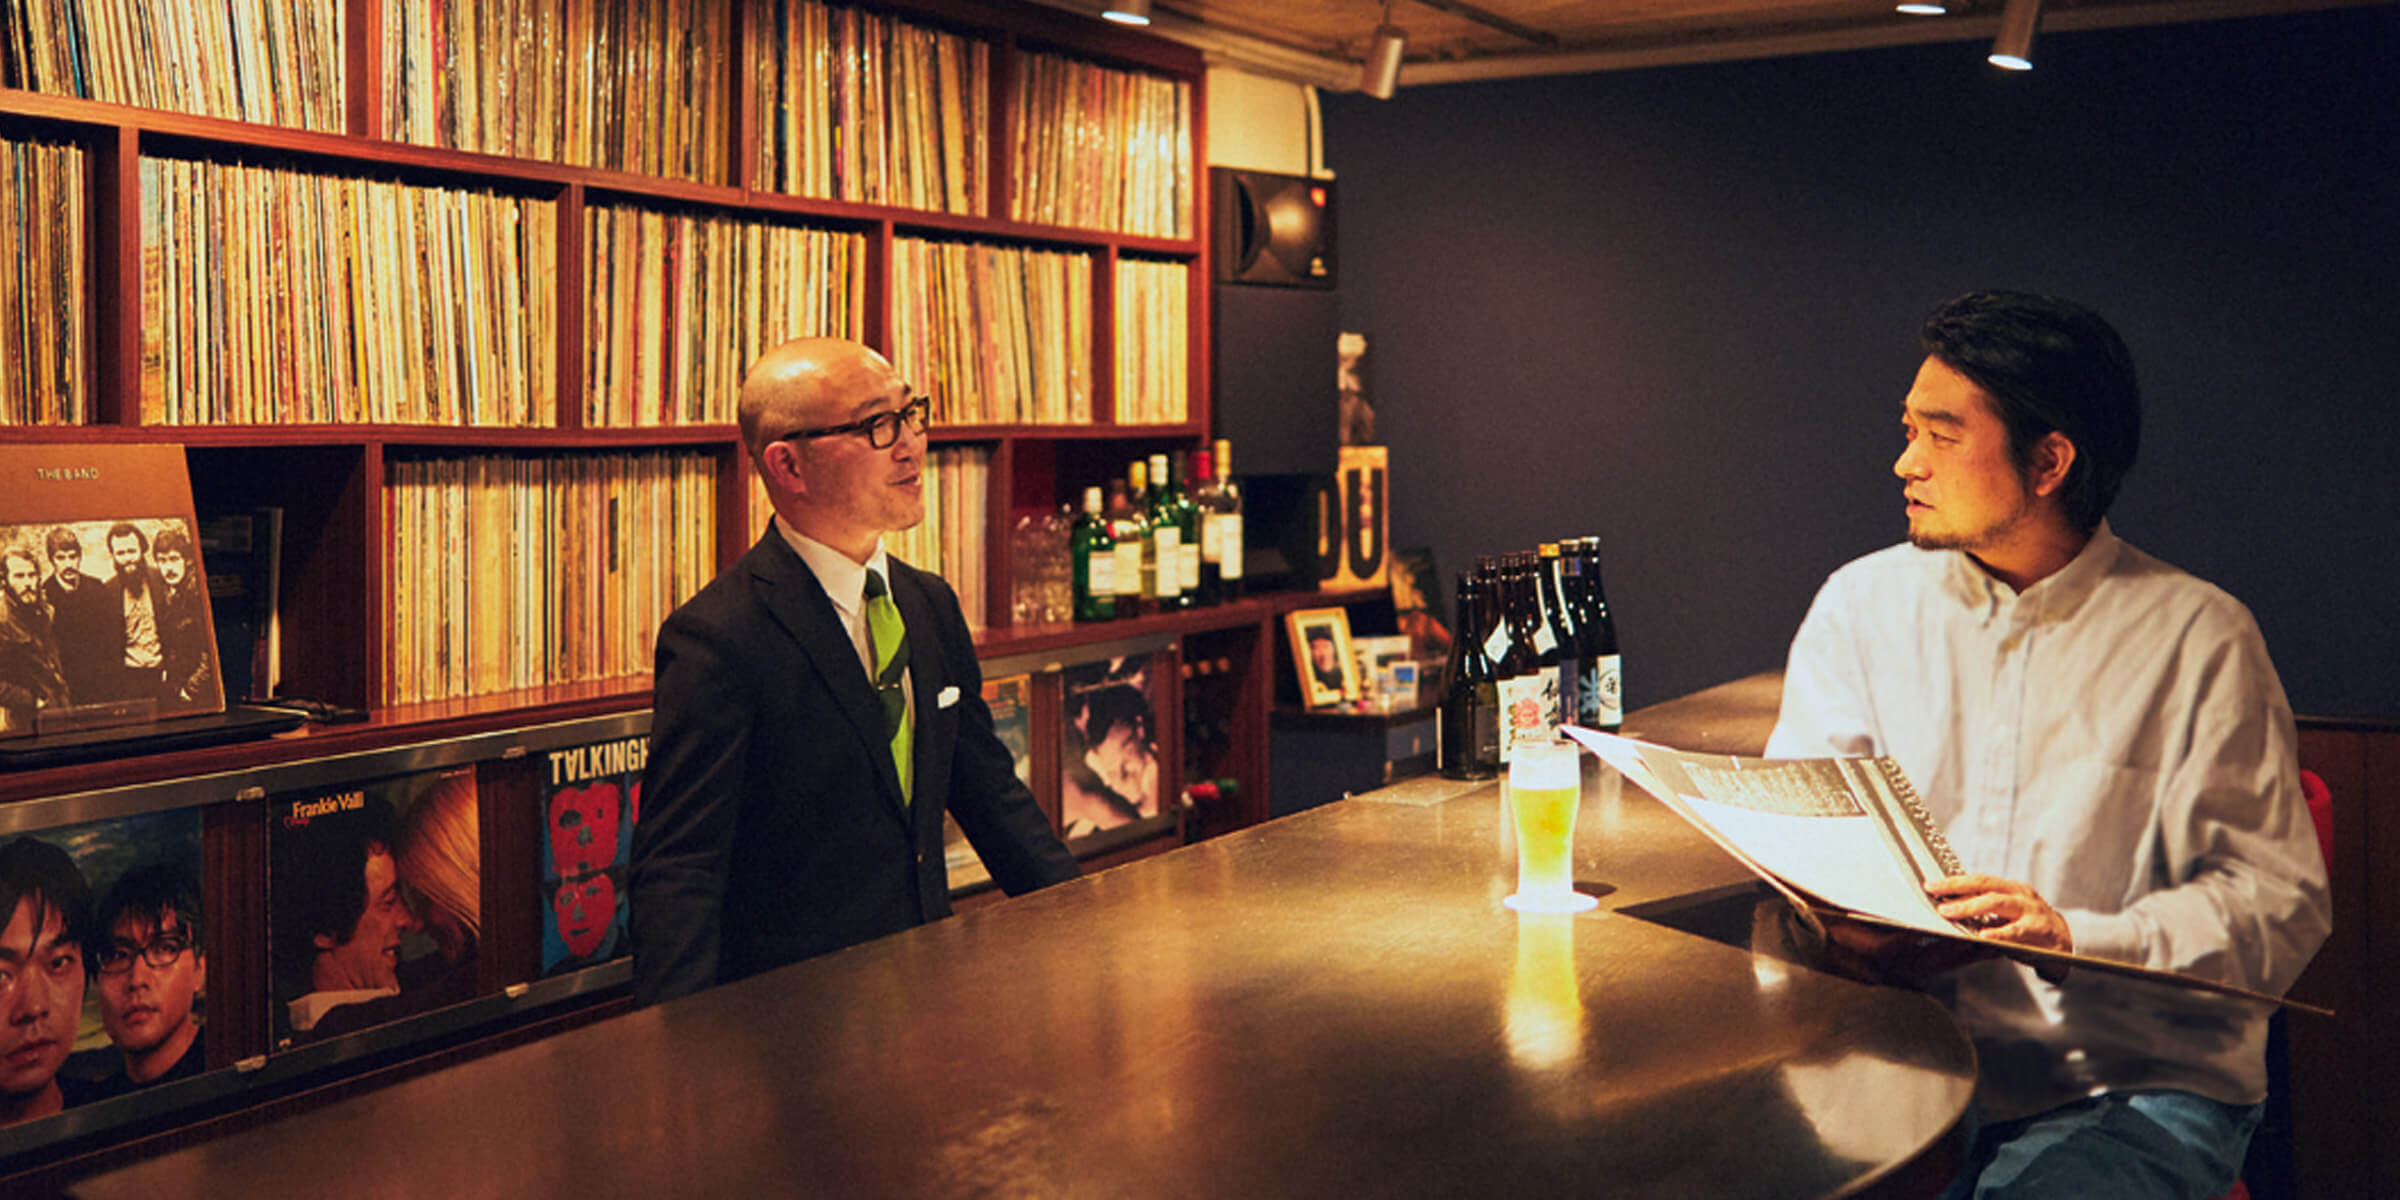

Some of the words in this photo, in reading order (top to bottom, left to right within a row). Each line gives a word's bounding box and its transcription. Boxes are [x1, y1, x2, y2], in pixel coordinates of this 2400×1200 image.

[36, 467, 61, 481] THE
[63, 466, 99, 481] BAND
[292, 796, 337, 819] Frankie
[337, 791, 365, 811] Valli
